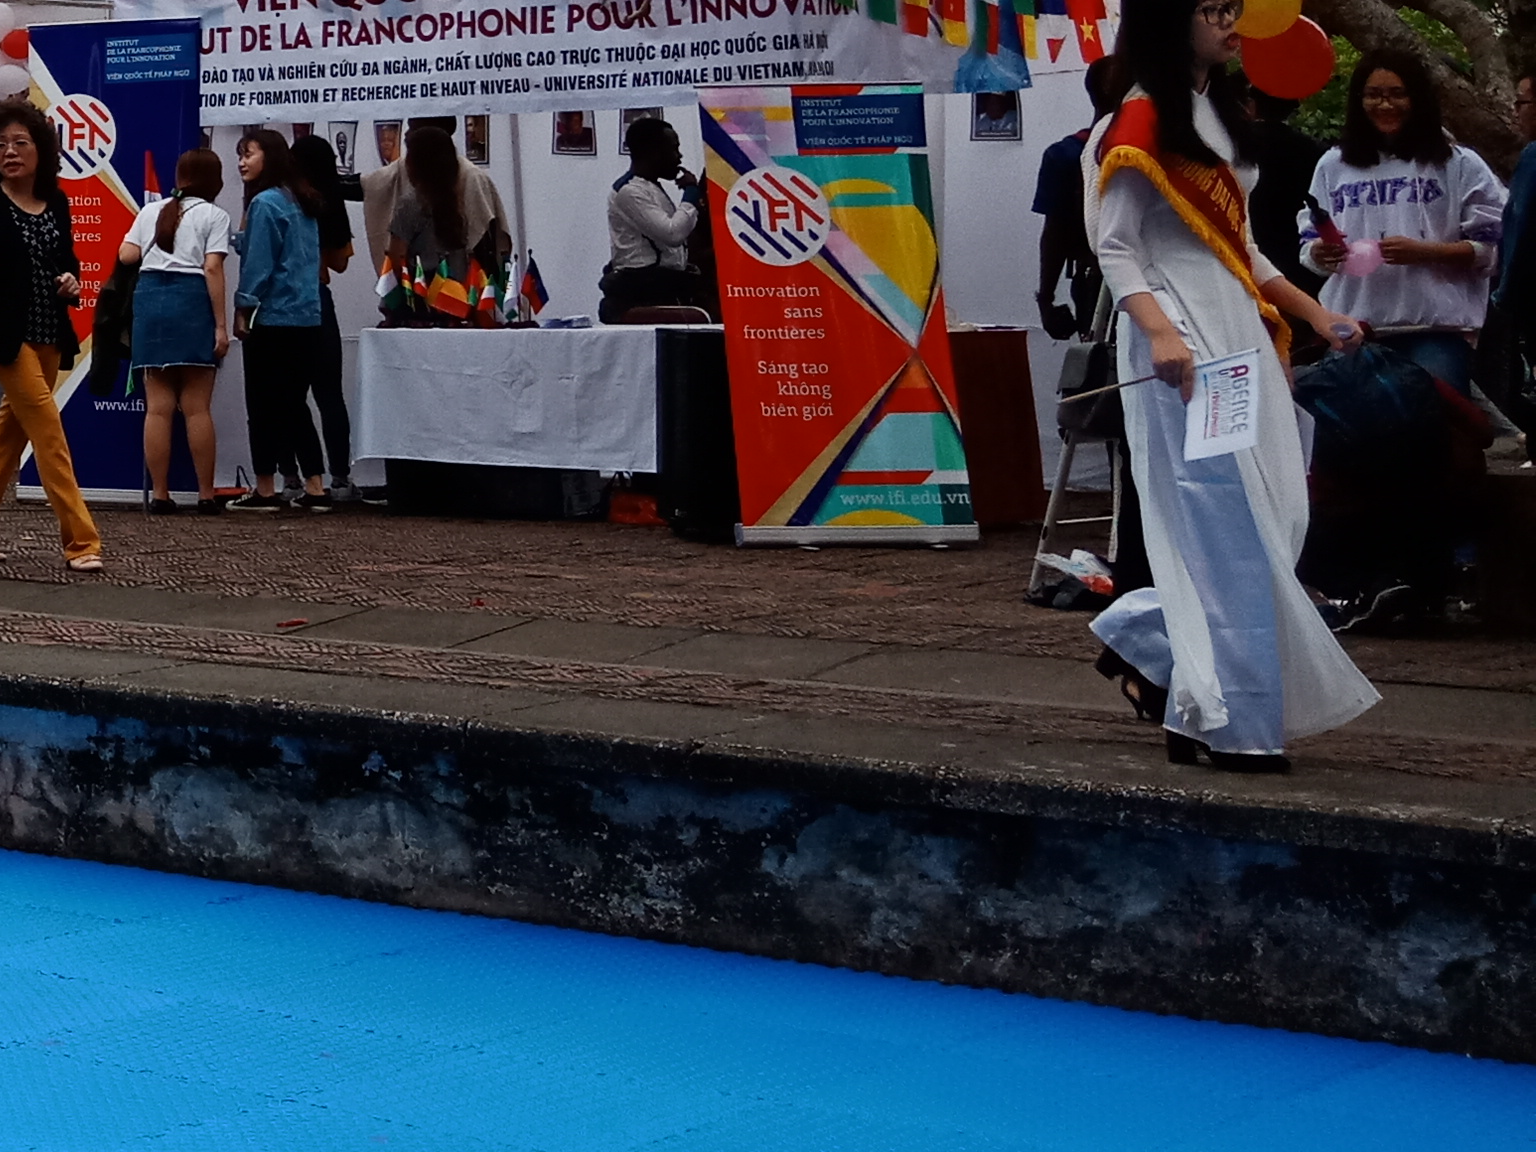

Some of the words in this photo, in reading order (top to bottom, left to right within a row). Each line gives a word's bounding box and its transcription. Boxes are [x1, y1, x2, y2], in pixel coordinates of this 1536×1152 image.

[200, 27, 232, 55] UT
[241, 24, 272, 52] DE
[281, 22, 312, 50] LA
[322, 5, 556, 48] FRANCOPHONIE
[567, 0, 657, 32] POUR
[202, 65, 227, 84] ĐÀO
[232, 67, 255, 85] TẠO
[258, 63, 275, 82] VÀ
[278, 61, 326, 80] NGHIÊN
[330, 59, 357, 78] CỨU
[361, 62, 378, 76] ĐA
[384, 57, 432, 75] NGÀNH,
[436, 50, 471, 72] CHẤT
[475, 50, 522, 72] LƯỢNG
[526, 51, 556, 67] CAO
[560, 47, 600, 68] TRỰC
[605, 43, 656, 65] THUỘC
[661, 43, 686, 63] ĐẠI
[690, 39, 721, 61] HỌC
[724, 31, 767, 56] QUỐC
[773, 34, 800, 50] GIA
[229, 92, 245, 106] DE
[249, 89, 319, 107] FORMATION
[323, 88, 338, 103] ET
[341, 84, 417, 102] RECHERCHE
[421, 82, 437, 98] DE
[441, 80, 476, 97] HAUT
[480, 78, 530, 96] NIVEAU
[544, 70, 627, 92] UNIVERSITÉ
[632, 68, 708, 88] NATIONALE
[713, 66, 732, 82] DU
[71, 214, 102, 225] sans
[726, 283, 821, 298] Innovation
[784, 307, 823, 319] sans
[743, 324, 826, 340] frontières
[757, 360, 799, 379] Sáng
[802, 361, 829, 377] tạo
[777, 380, 833, 400] không
[760, 401, 798, 417] biên
[802, 403, 834, 421] giới
[840, 490, 971, 506] www.ifi.edu.vn
